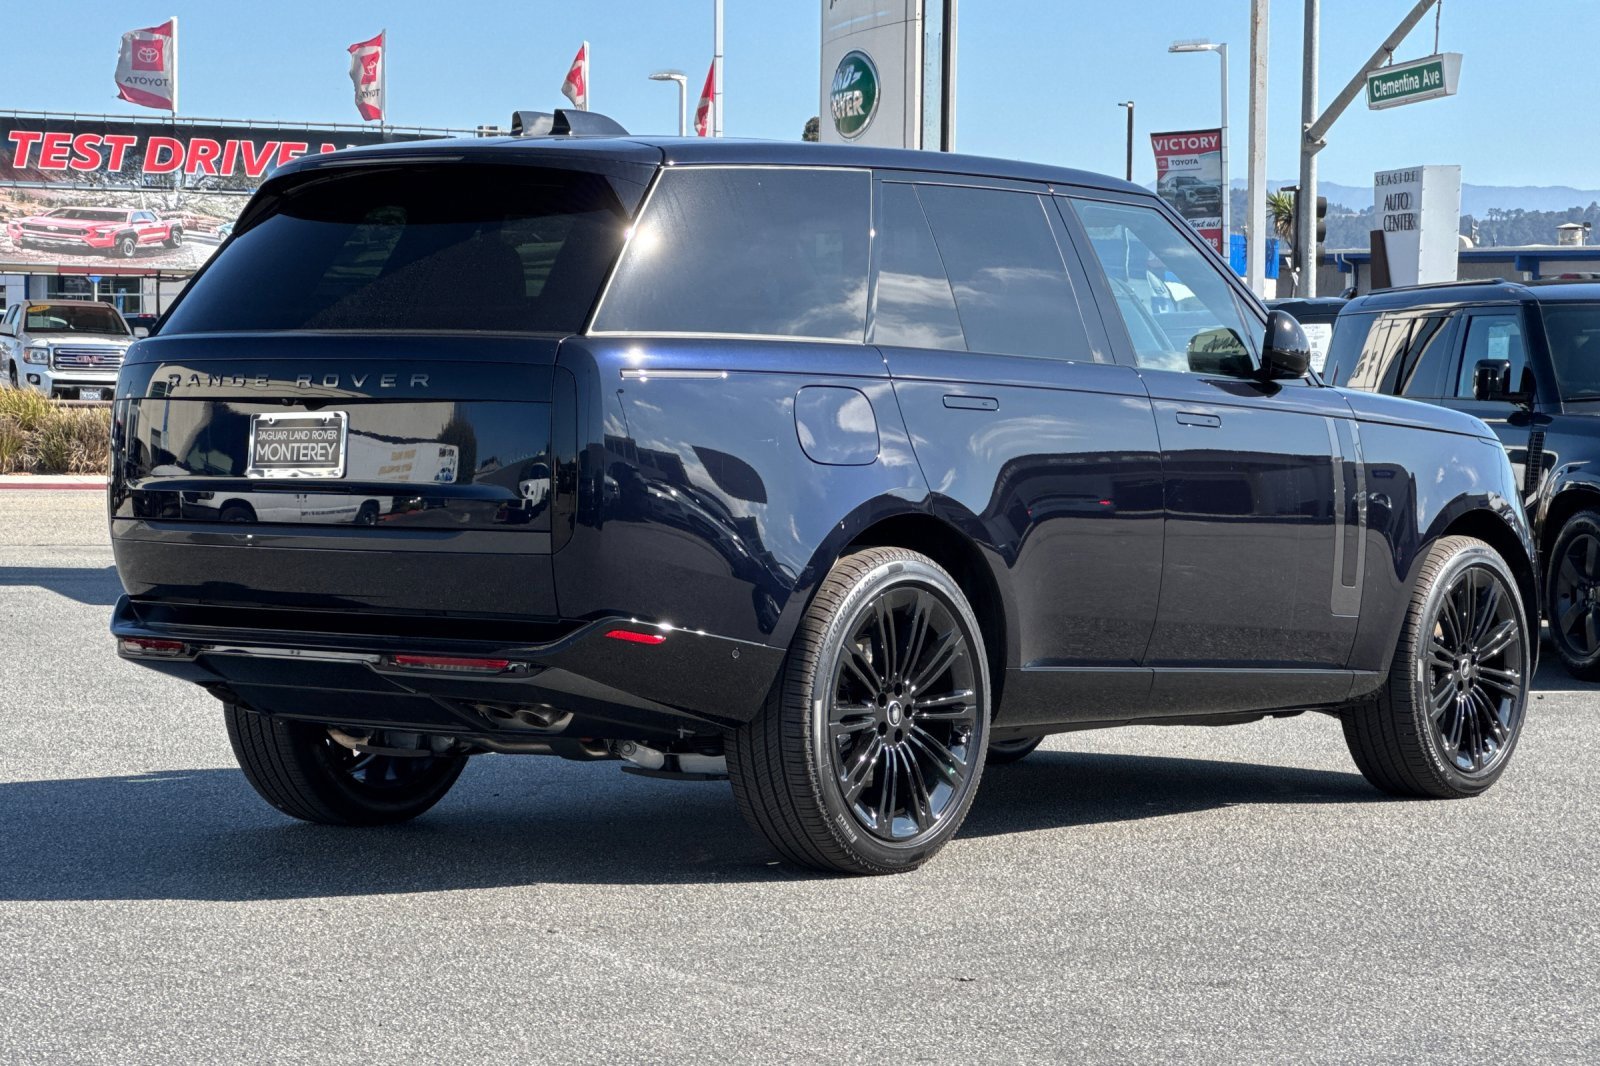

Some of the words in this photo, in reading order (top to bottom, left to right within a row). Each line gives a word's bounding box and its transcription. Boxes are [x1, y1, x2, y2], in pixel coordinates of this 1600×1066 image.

[1373, 73, 1420, 97] Clementina
[1422, 69, 1440, 87] Ave
[1153, 136, 1217, 151] VICTORY
[8, 131, 138, 172] TEST
[142, 136, 309, 178] DRIVE
[1171, 158, 1198, 166] TOYOTA
[1375, 170, 1416, 186] SEASIDE
[1384, 192, 1409, 211] AUTO
[1206, 218, 1221, 227] us!
[1383, 213, 1415, 232] CENTER
[168, 373, 270, 387] RANGE
[296, 373, 430, 388] ROVER
[258, 430, 288, 440] JAGUAR
[289, 430, 310, 440] LAND
[312, 430, 338, 440] ROVER
[255, 442, 337, 461] MONTEREY
